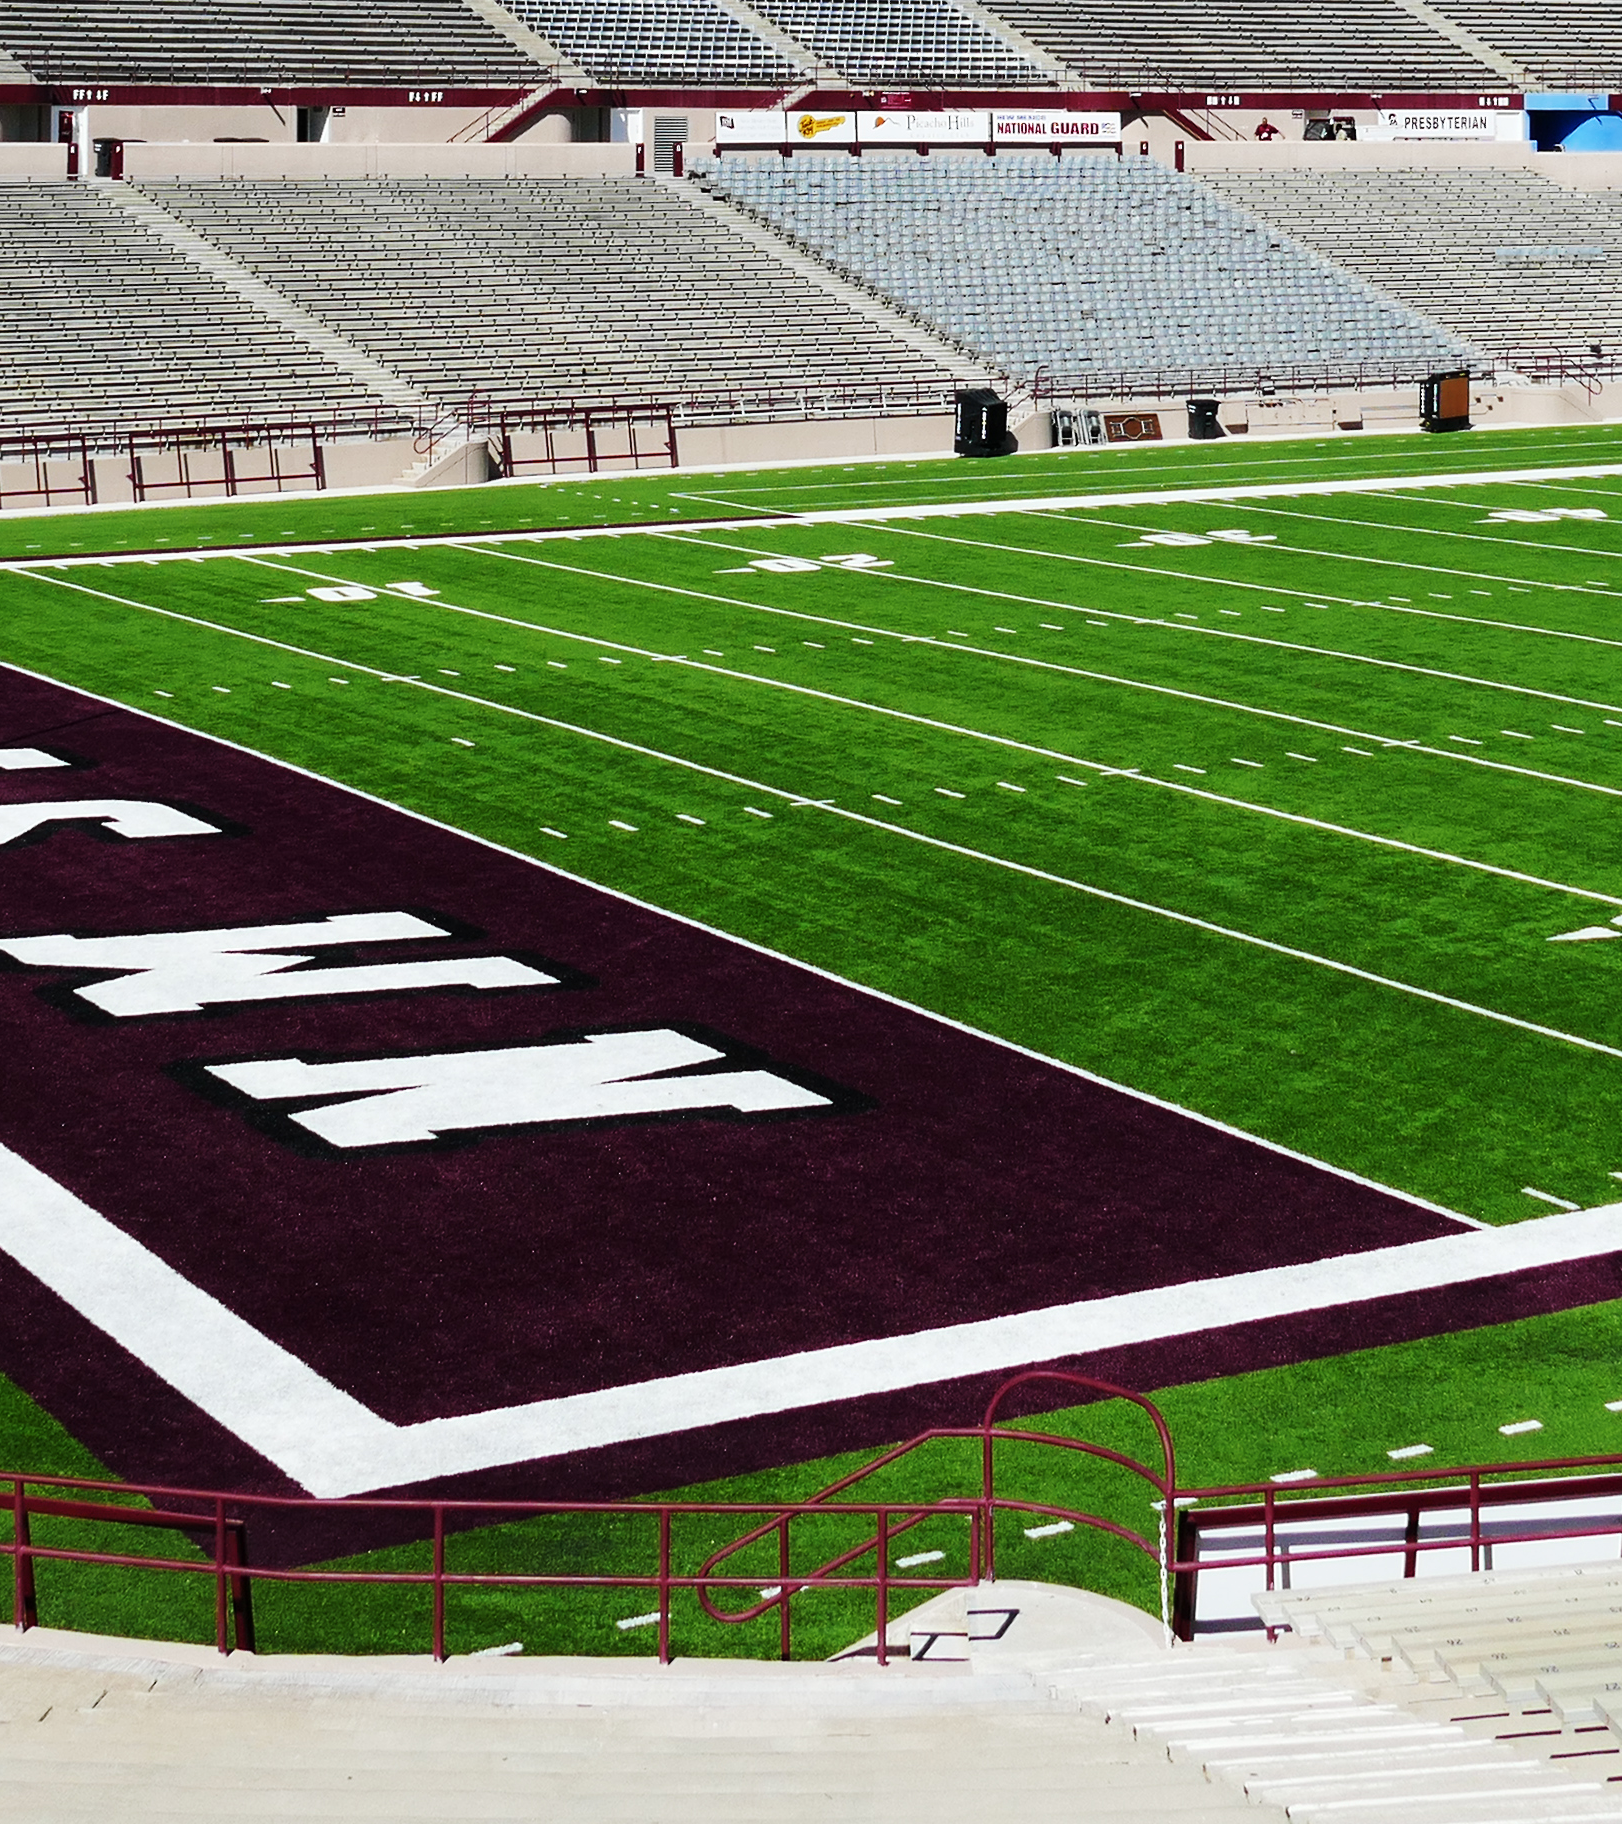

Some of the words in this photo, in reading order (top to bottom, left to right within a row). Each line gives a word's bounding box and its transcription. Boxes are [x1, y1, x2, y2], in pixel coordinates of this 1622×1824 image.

[73, 89, 85, 100] FF
[103, 90, 109, 100] F
[997, 122, 1047, 135] NATIONAL
[1050, 122, 1099, 135] GUARD
[1404, 116, 1487, 130] PRESBYTERIAN
